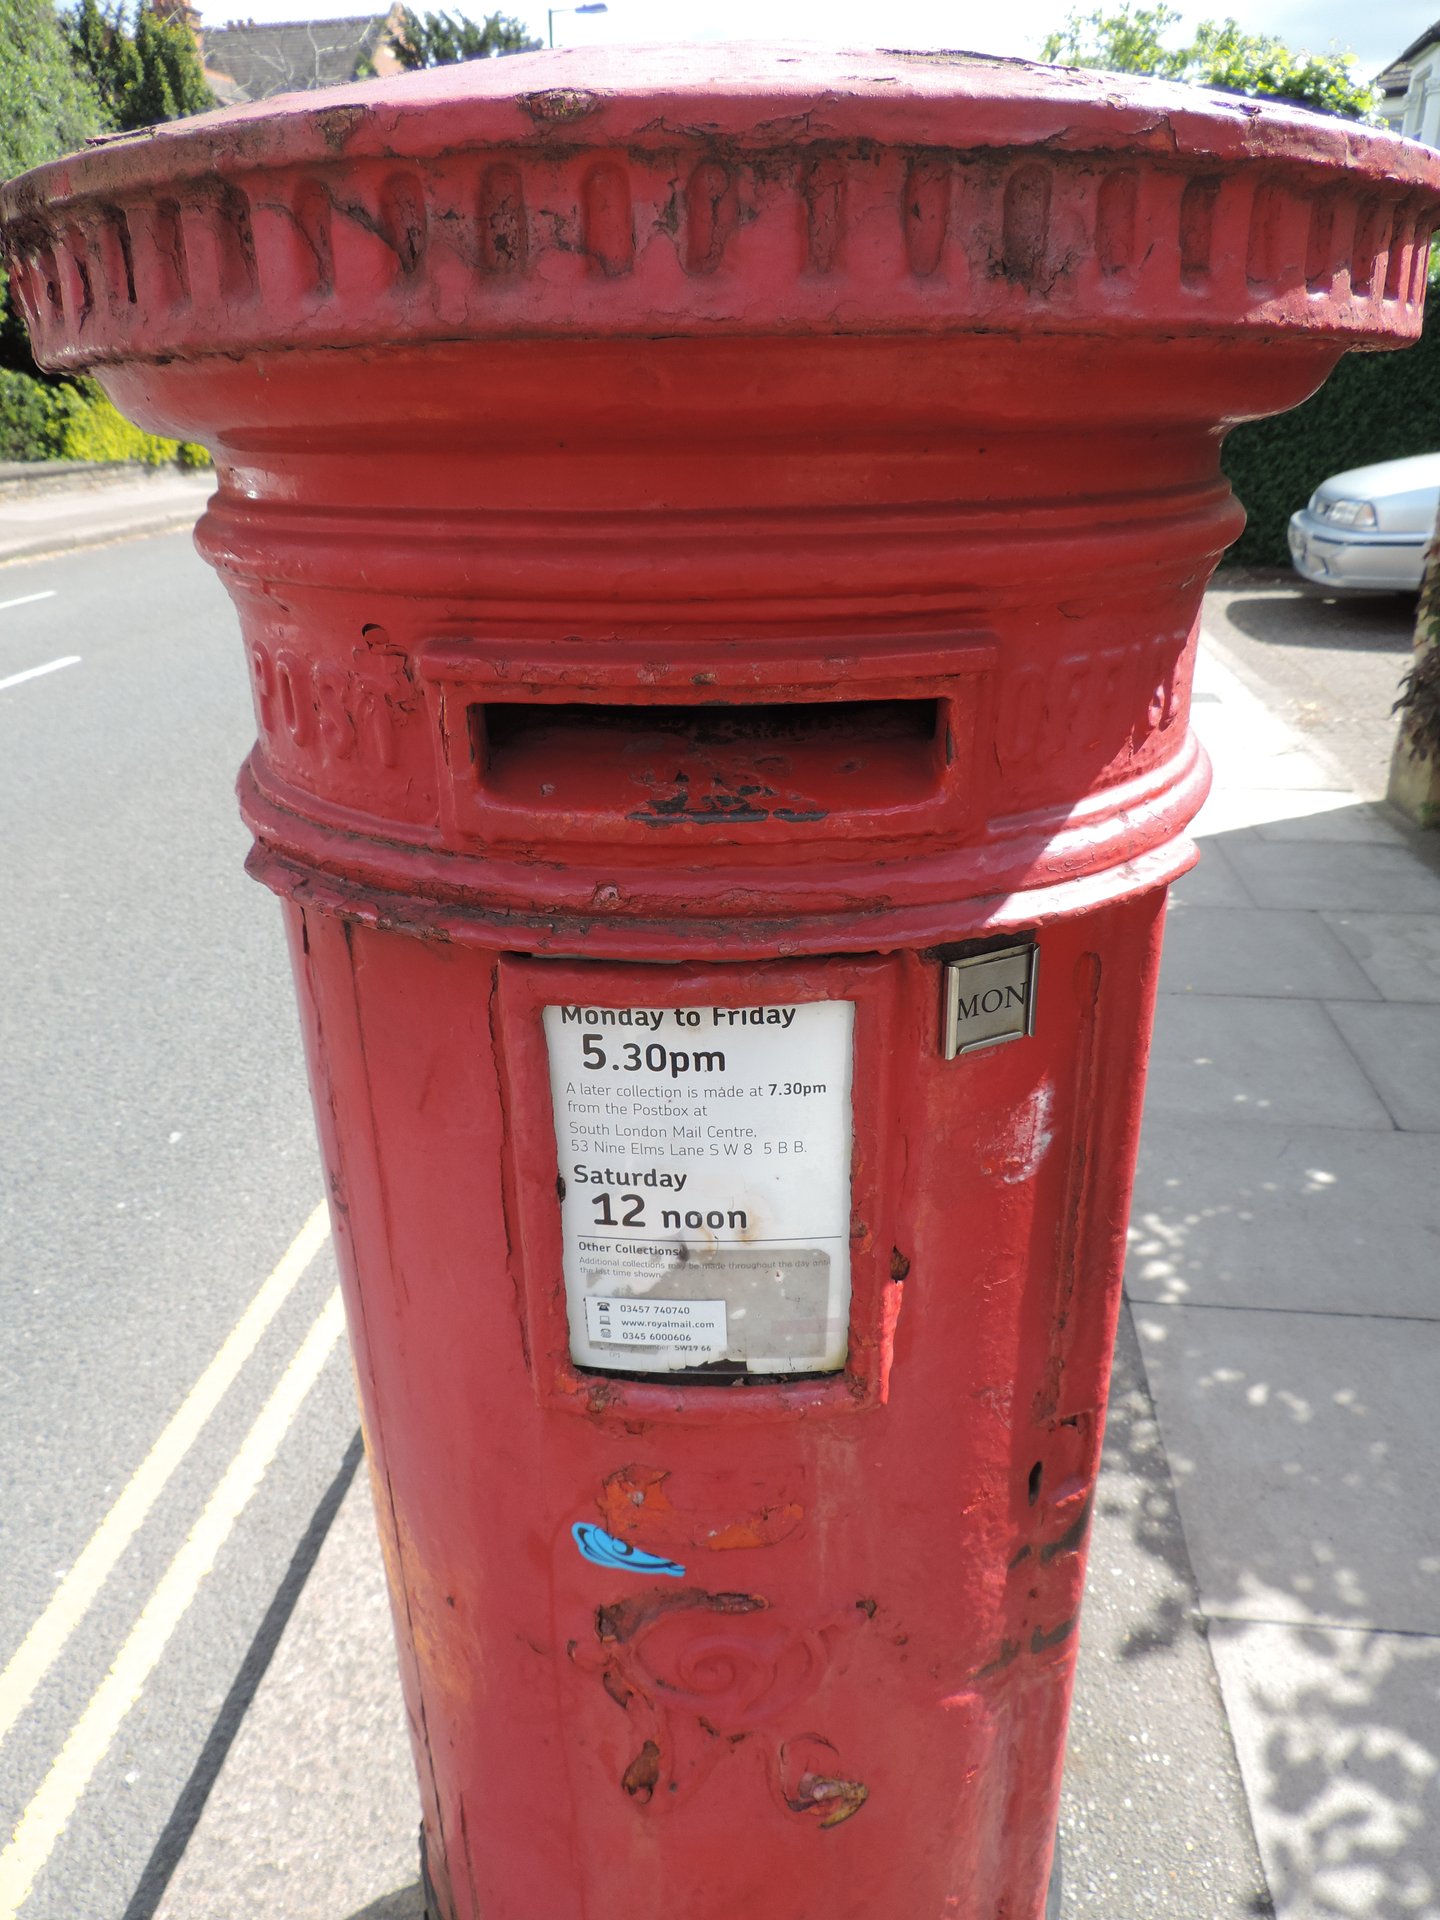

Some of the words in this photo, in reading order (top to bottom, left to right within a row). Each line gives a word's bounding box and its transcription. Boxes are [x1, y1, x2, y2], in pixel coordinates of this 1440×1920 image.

[958, 981, 1028, 1021] MON
[561, 1006, 664, 1031] Monday
[674, 1008, 701, 1027] to
[713, 1007, 796, 1029] Friday
[582, 1033, 726, 1078] 5.30pm
[566, 1082, 576, 1095] A
[580, 1083, 612, 1096] later
[616, 1085, 682, 1098] collection
[687, 1086, 698, 1098] is
[704, 1085, 744, 1098] made
[749, 1086, 763, 1097] at
[768, 1082, 827, 1096] 7.30pm
[568, 1100, 600, 1113] from
[605, 1103, 628, 1115] the
[633, 1103, 689, 1116] Postbox
[693, 1105, 708, 1117] at
[569, 1122, 610, 1136] South
[615, 1124, 667, 1137] London
[673, 1126, 702, 1138] Mail
[571, 1140, 589, 1152] 53
[594, 1141, 626, 1154] Nine
[631, 1142, 665, 1155] Elms
[670, 1144, 704, 1156] Lane
[573, 1164, 688, 1192] Saturday
[592, 1192, 646, 1227] 12
[661, 1210, 747, 1229] noon
[578, 1241, 611, 1253] Other
[615, 1244, 679, 1256] Collections
[579, 1257, 620, 1267] Additional
[622, 1259, 665, 1269] collections
[689, 1262, 700, 1270] be
[728, 1260, 776, 1271] throughout
[778, 1259, 793, 1268] the
[580, 1266, 593, 1274] the
[613, 1268, 631, 1277] time
[620, 1304, 650, 1314] 03457
[653, 1306, 690, 1315] 740740
[621, 1318, 715, 1329] www.royalmail.com
[622, 1332, 646, 1341] 0345
[649, 1333, 692, 1342] 6000606
[674, 1344, 699, 1352] SW19
